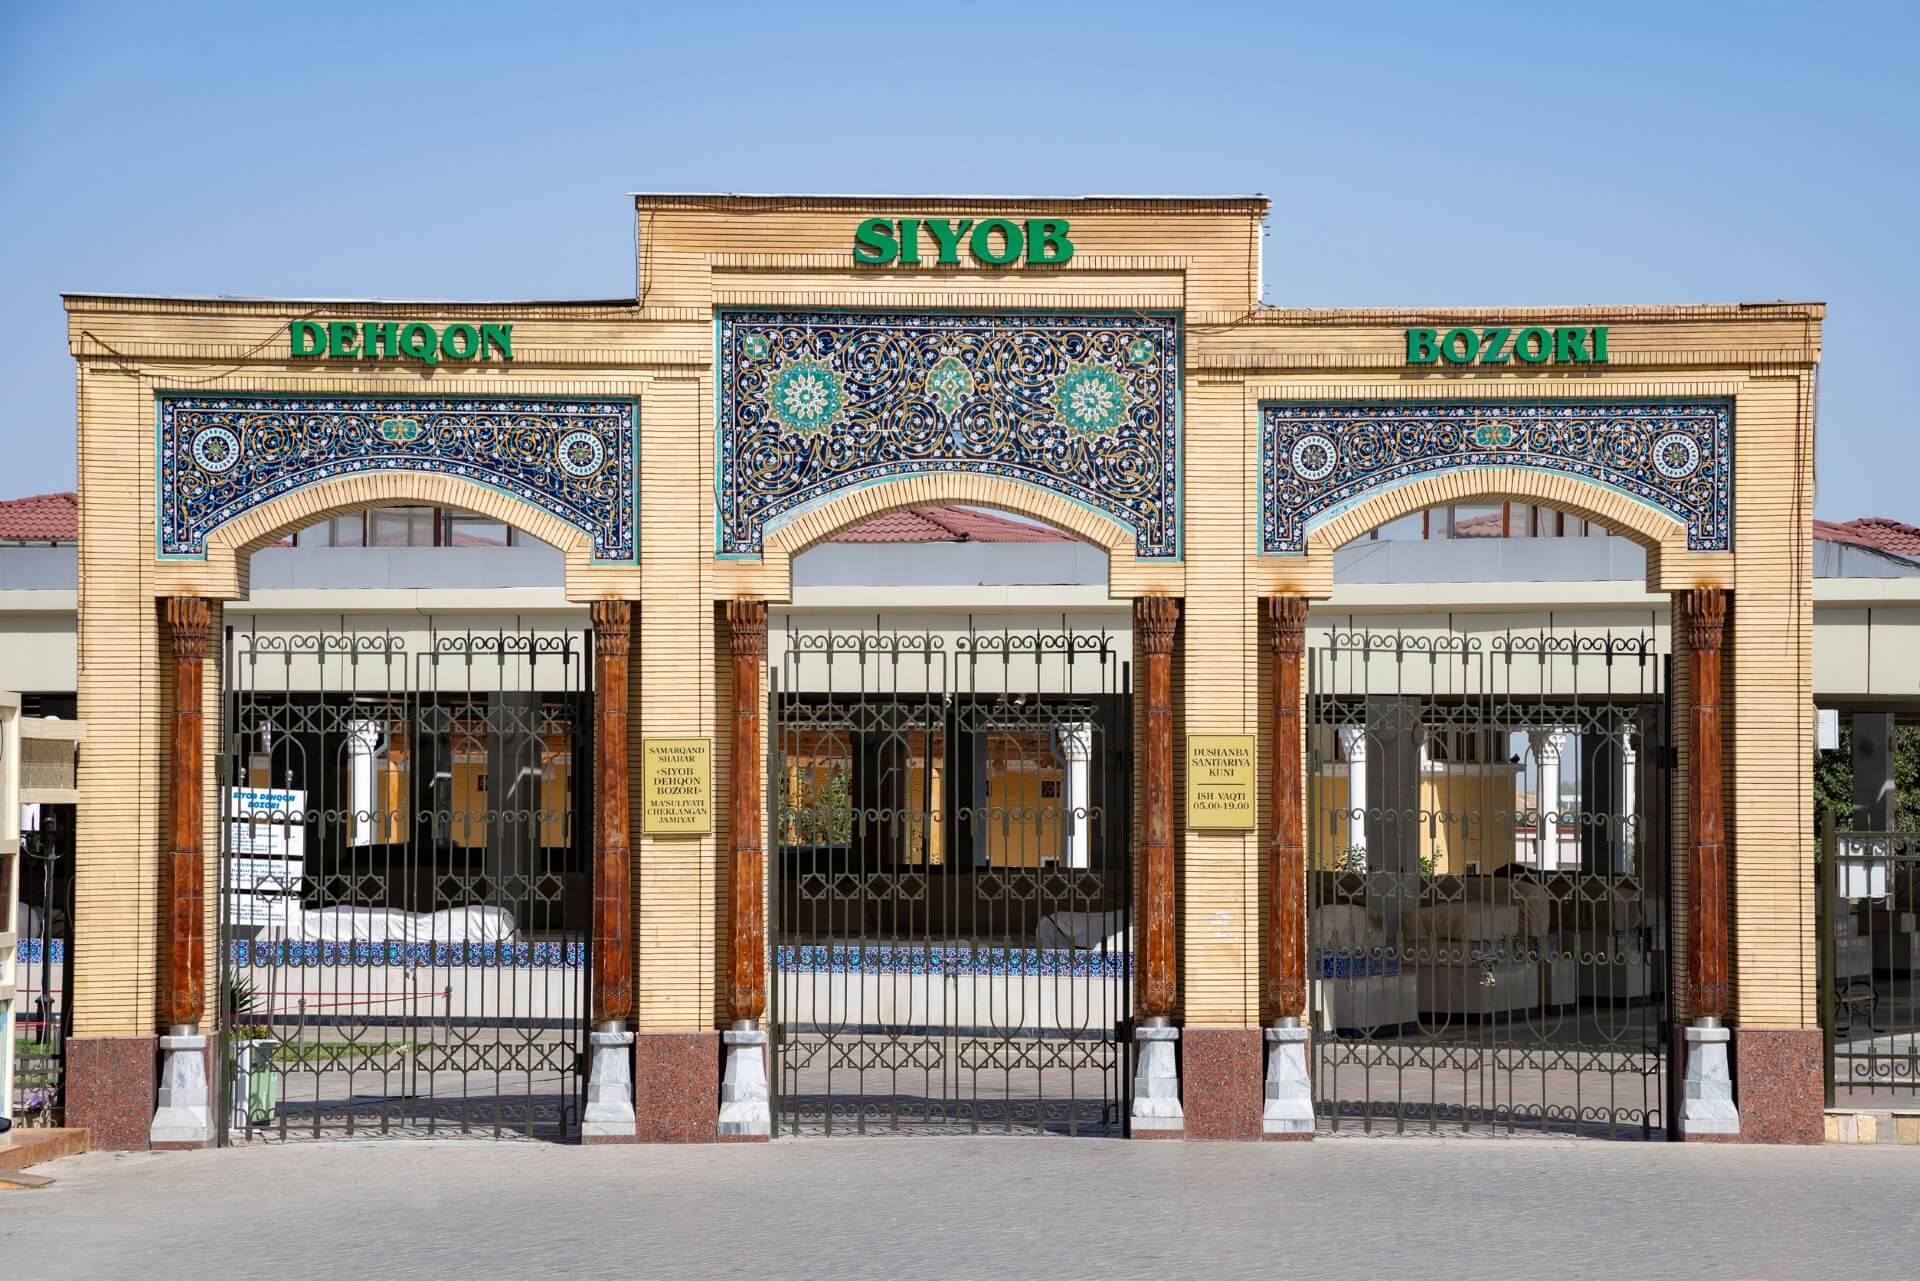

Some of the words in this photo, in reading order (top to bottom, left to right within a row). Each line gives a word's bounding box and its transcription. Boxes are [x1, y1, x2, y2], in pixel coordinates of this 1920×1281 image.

[855, 217, 1075, 265] SIYOB
[290, 320, 513, 366] DEHQON
[1405, 326, 1609, 363] BOZORI
[649, 747, 705, 755] SAMARQAND
[1194, 748, 1249, 757] DUSHANBA
[658, 755, 695, 763] SHAHAR
[1191, 758, 1250, 767] SANITARIYA
[1209, 768, 1234, 777] KUNI
[653, 777, 701, 786] DEHQON
[1197, 792, 1214, 800] ISH
[1217, 792, 1246, 802] VAQTI
[1193, 801, 1250, 810] 05.00-19.00
[647, 808, 707, 816] CHEKLANGAN
[658, 816, 697, 824] JAMIYAT
